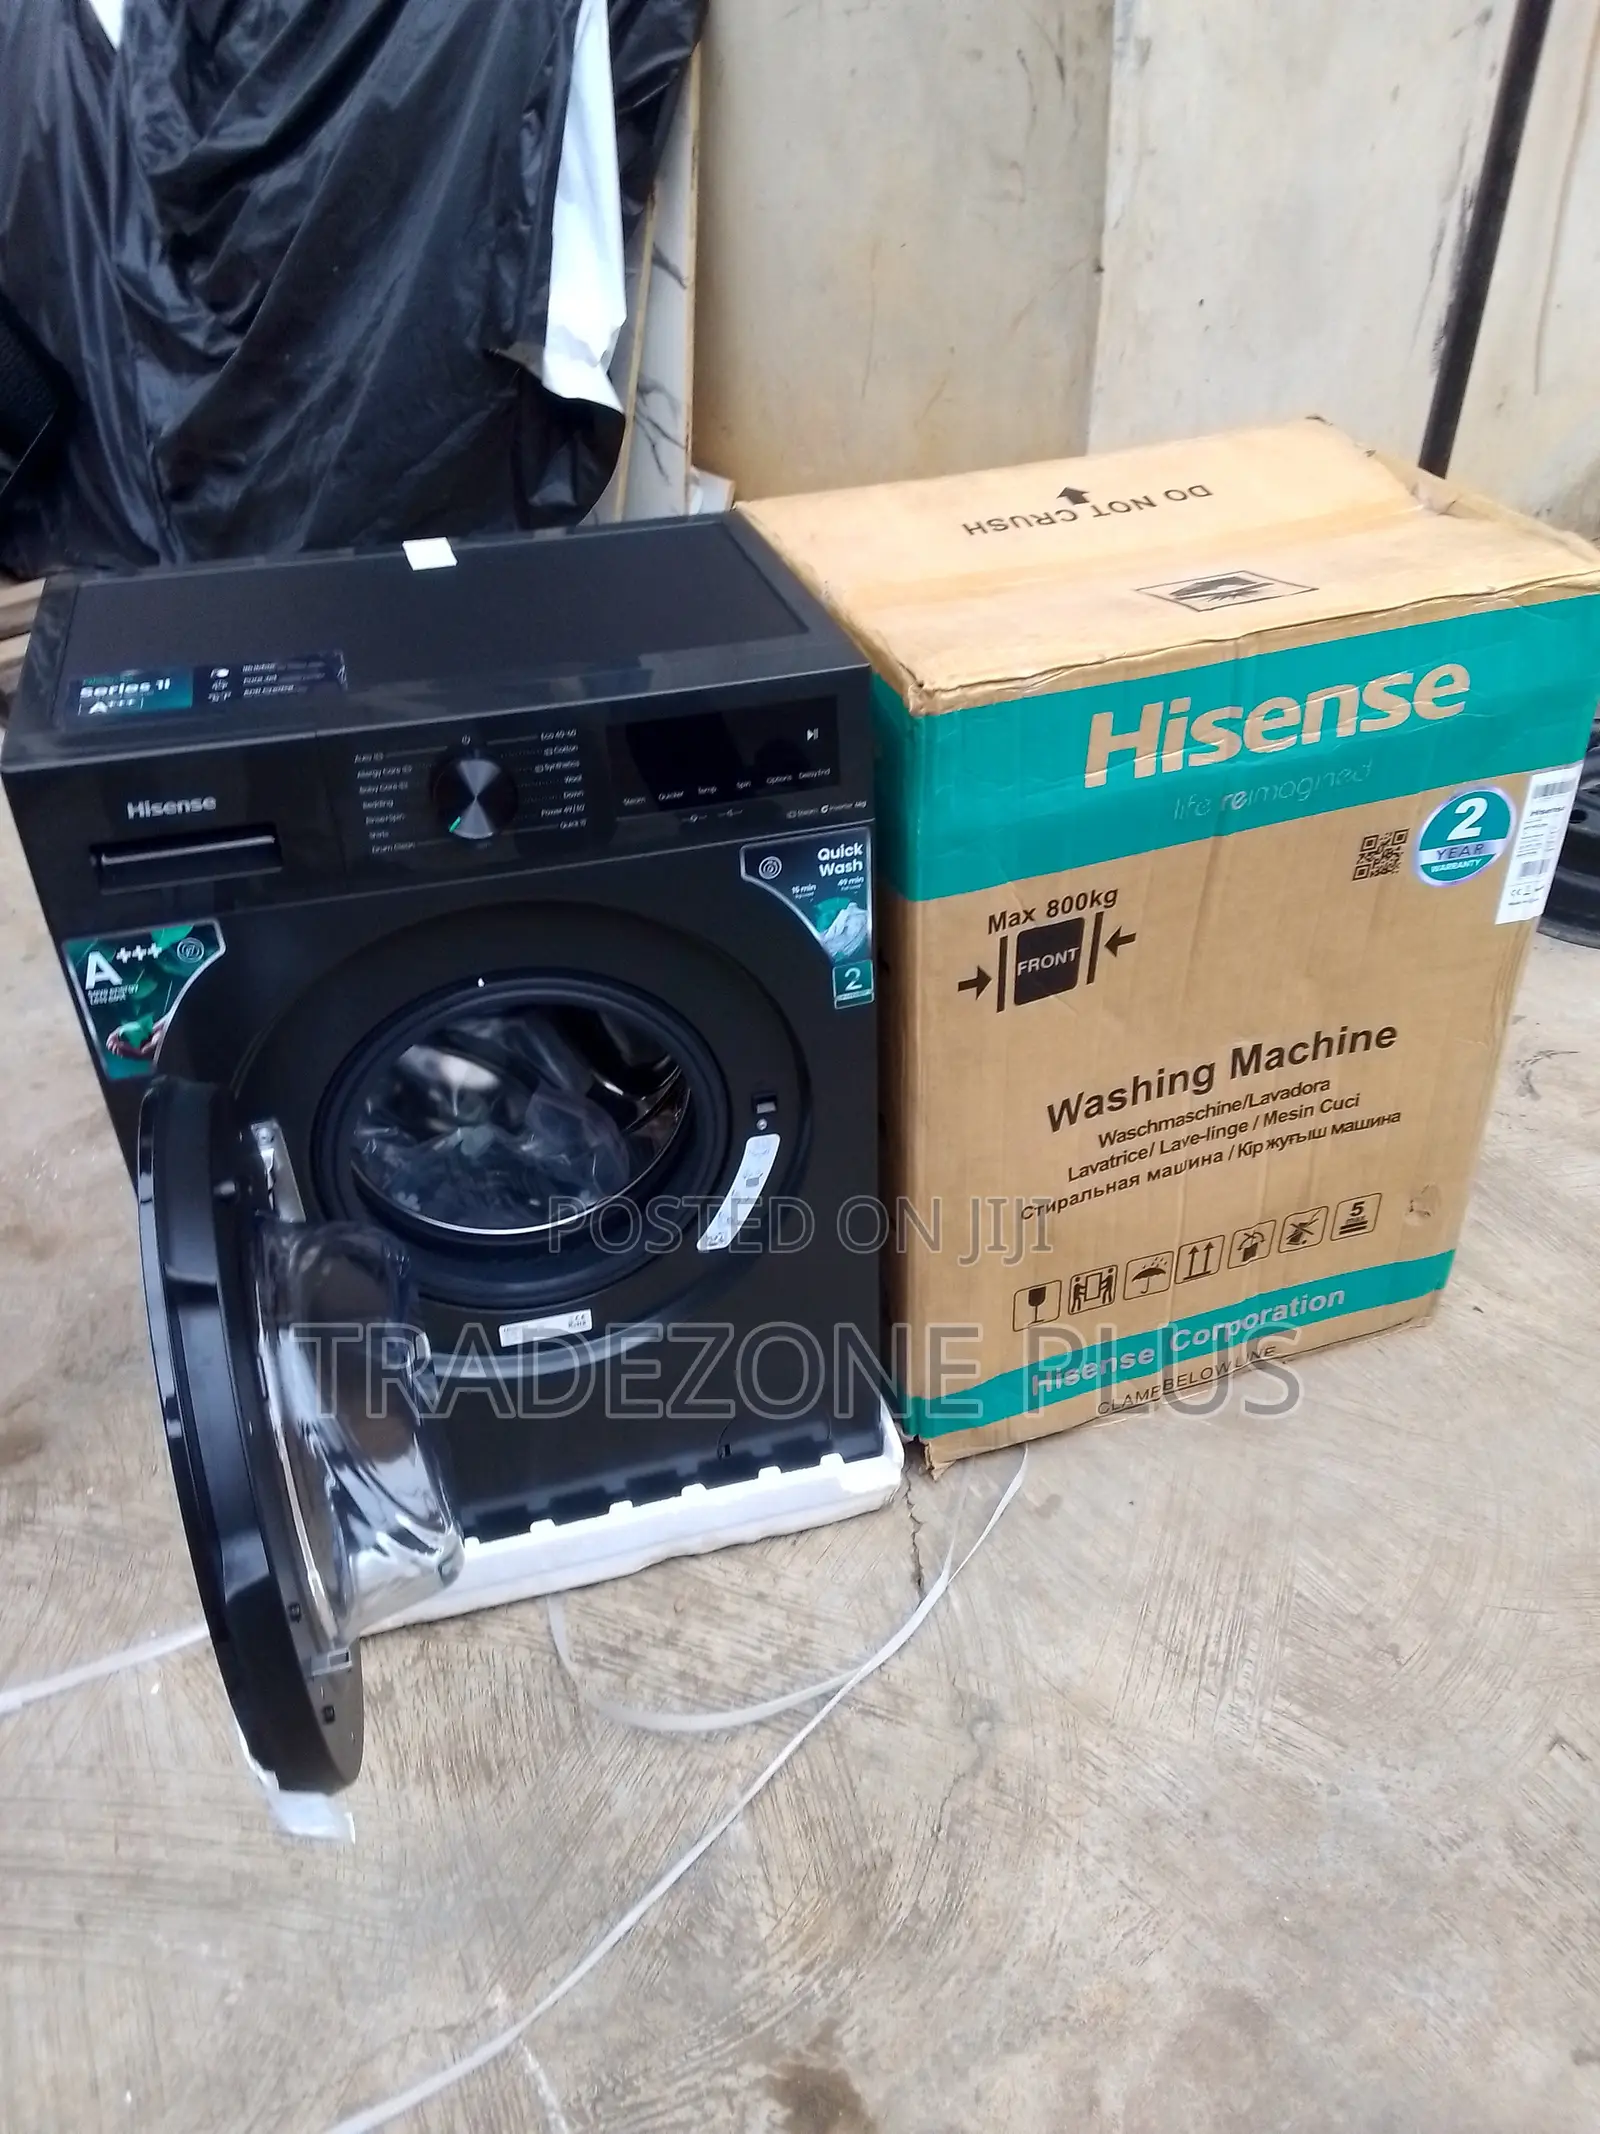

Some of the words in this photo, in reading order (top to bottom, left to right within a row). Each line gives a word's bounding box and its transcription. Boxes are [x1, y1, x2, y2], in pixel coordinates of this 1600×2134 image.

[1091, 495, 1158, 518] NOT
[1163, 484, 1213, 501] DO
[961, 509, 1078, 536] CRUSH
[1084, 663, 1471, 788] Hisense
[1173, 796, 1212, 820] life
[1221, 758, 1373, 813] reimagined
[127, 796, 217, 819] Hisense
[1446, 797, 1488, 841] 2
[817, 842, 864, 862] Quick
[1430, 859, 1483, 873] WARRANTY
[1437, 844, 1485, 860] YEAR
[818, 858, 864, 878] Wash
[987, 908, 1036, 935] Max
[1046, 888, 1119, 918] 800kg
[85, 942, 163, 990] A+++
[1017, 947, 1080, 976] FRONT
[844, 967, 863, 992] 2
[1047, 1062, 1216, 1133] Washing
[1230, 1025, 1398, 1080] Machine
[1098, 1078, 1330, 1149] Waschmaschine/Lavadora
[1067, 1142, 1156, 1182] Lavatrice/
[1159, 1120, 1249, 1156] Lave-linge
[1263, 1104, 1315, 1127] Mesin
[1320, 1093, 1361, 1115] Cuci
[1020, 1173, 1141, 1221] Стиральная
[1146, 1151, 1224, 1183] машина
[1331, 1111, 1402, 1136] машина
[1349, 1201, 1365, 1217] 5
[1032, 1345, 1155, 1398] Hisense
[1169, 1288, 1346, 1352] Corporation
[1162, 1360, 1232, 1391] BELOW
